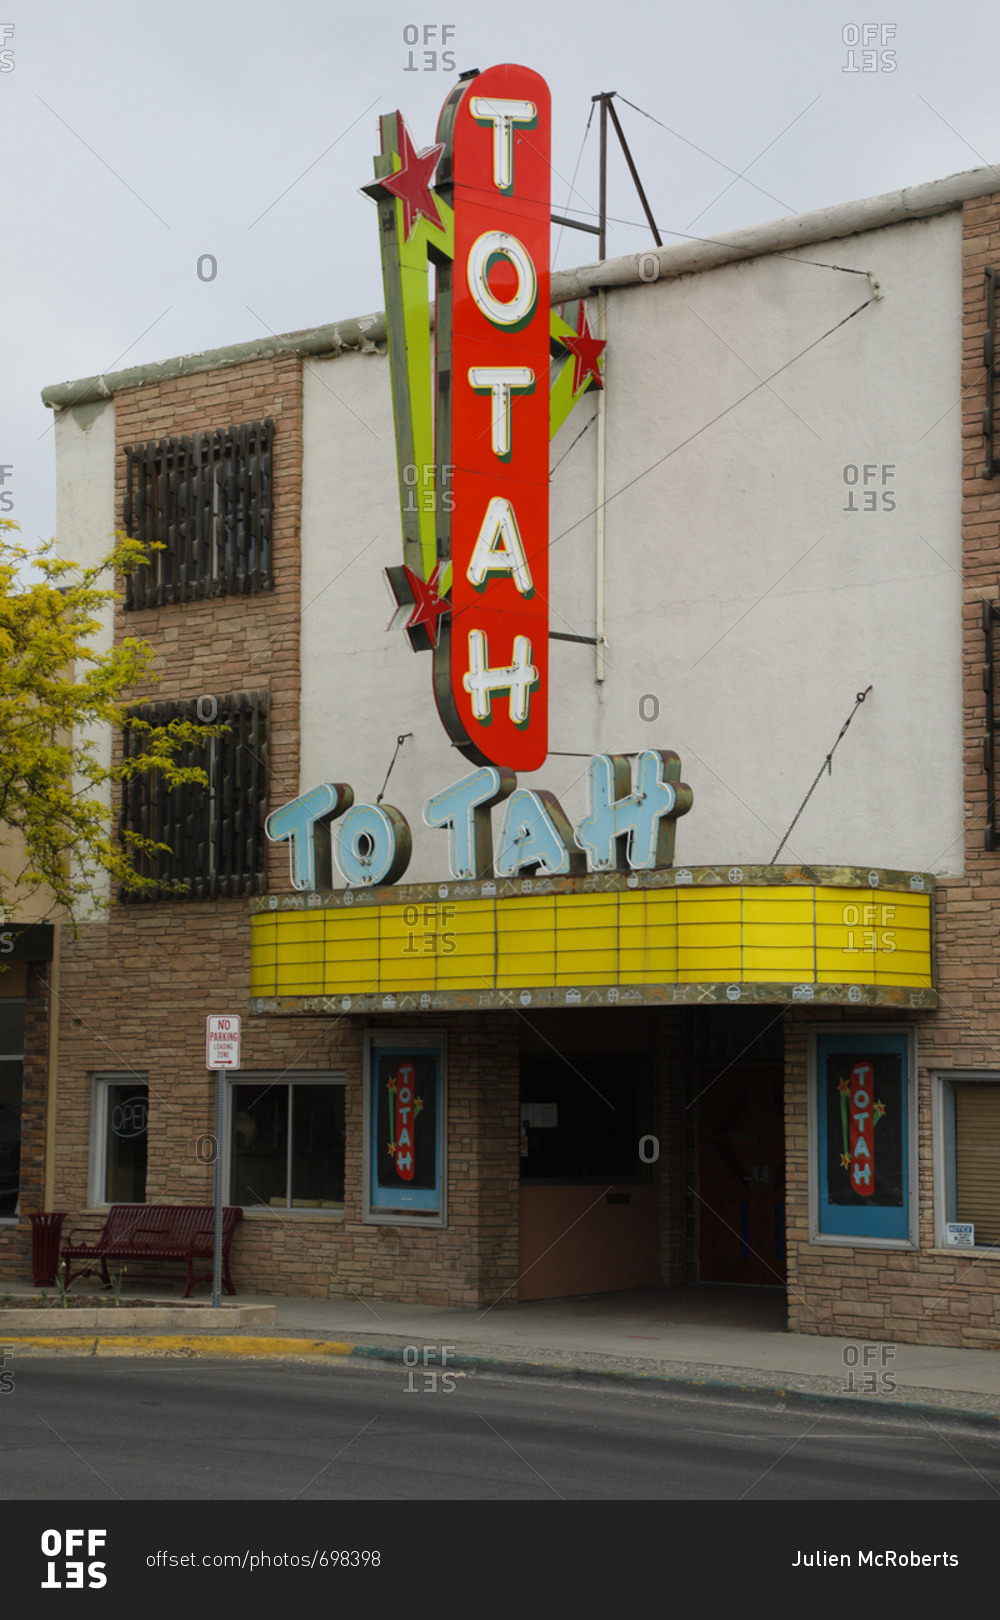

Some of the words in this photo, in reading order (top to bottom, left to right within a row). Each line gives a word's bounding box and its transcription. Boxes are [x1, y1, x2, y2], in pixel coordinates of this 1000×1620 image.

[463, 96, 540, 726] TOTAH
[210, 1031, 239, 1041] PARKING
[213, 1043, 233, 1051] LOADING
[217, 1019, 231, 1031] NO
[397, 1066, 413, 1171] TOTAH
[853, 1066, 872, 1186] TOTAH
